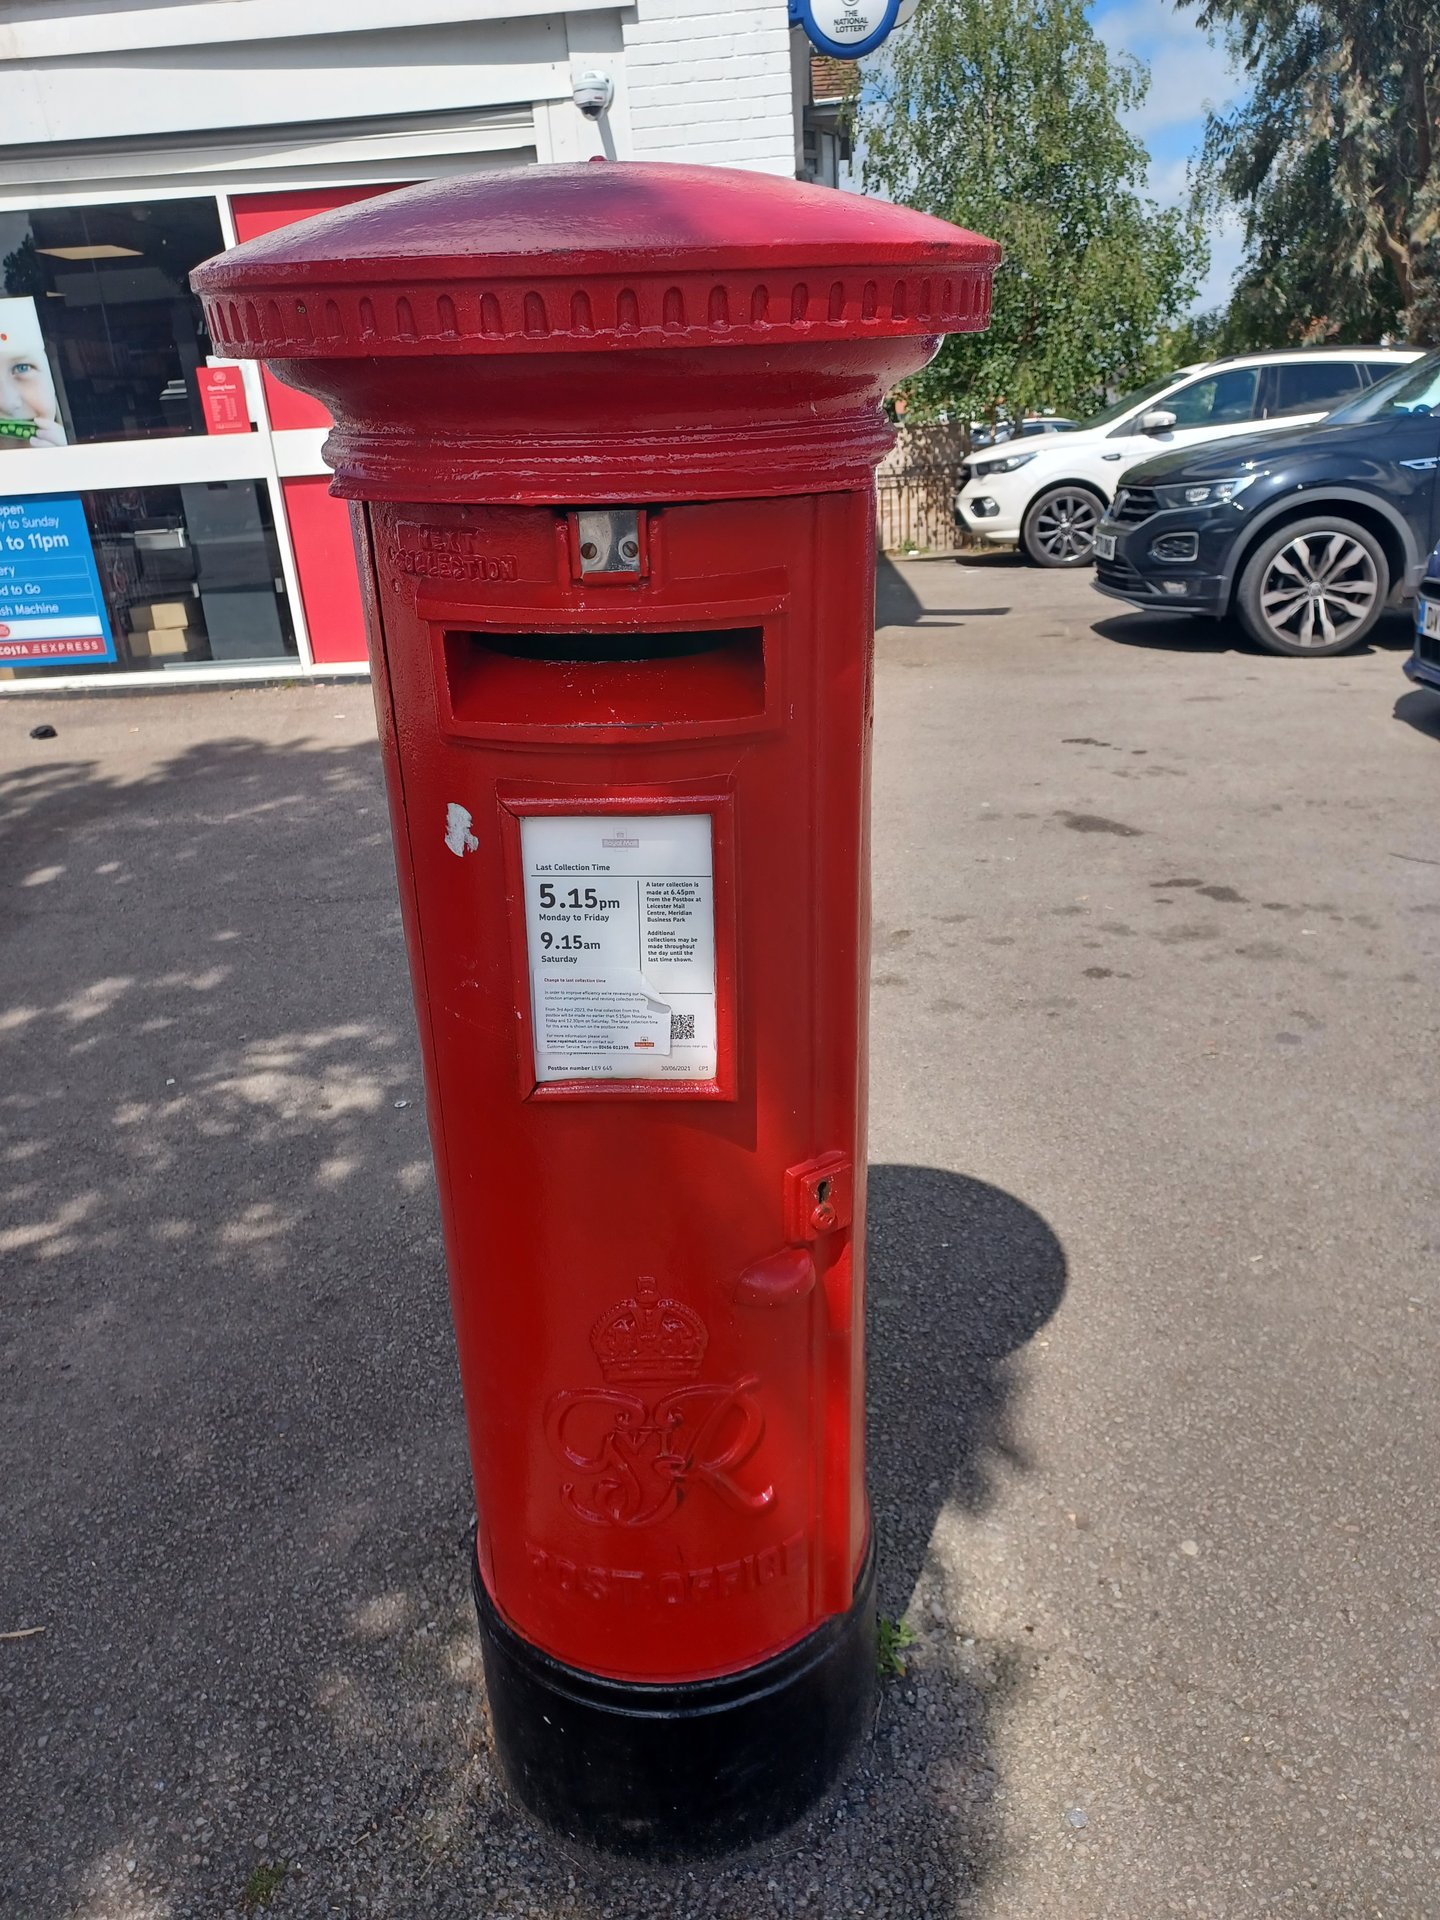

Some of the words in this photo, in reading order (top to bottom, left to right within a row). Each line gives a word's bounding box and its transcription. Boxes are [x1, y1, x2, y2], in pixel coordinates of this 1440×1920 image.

[834, 17, 868, 26] NATIONAL
[836, 24, 868, 33] LOTTERY
[8, 519, 20, 529] to
[22, 516, 59, 530] Sunday
[6, 536, 25, 551] to
[28, 532, 69, 552] 11pm
[11, 585, 23, 595] to
[24, 583, 41, 595] Go
[15, 602, 59, 615] Machine
[41, 641, 99, 654] EXPRESS
[540, 883, 620, 911] 5.15pm
[539, 914, 570, 922] Monday
[584, 914, 609, 922] Friday
[540, 931, 601, 950] 9.15am
[541, 955, 578, 964] Saturday
